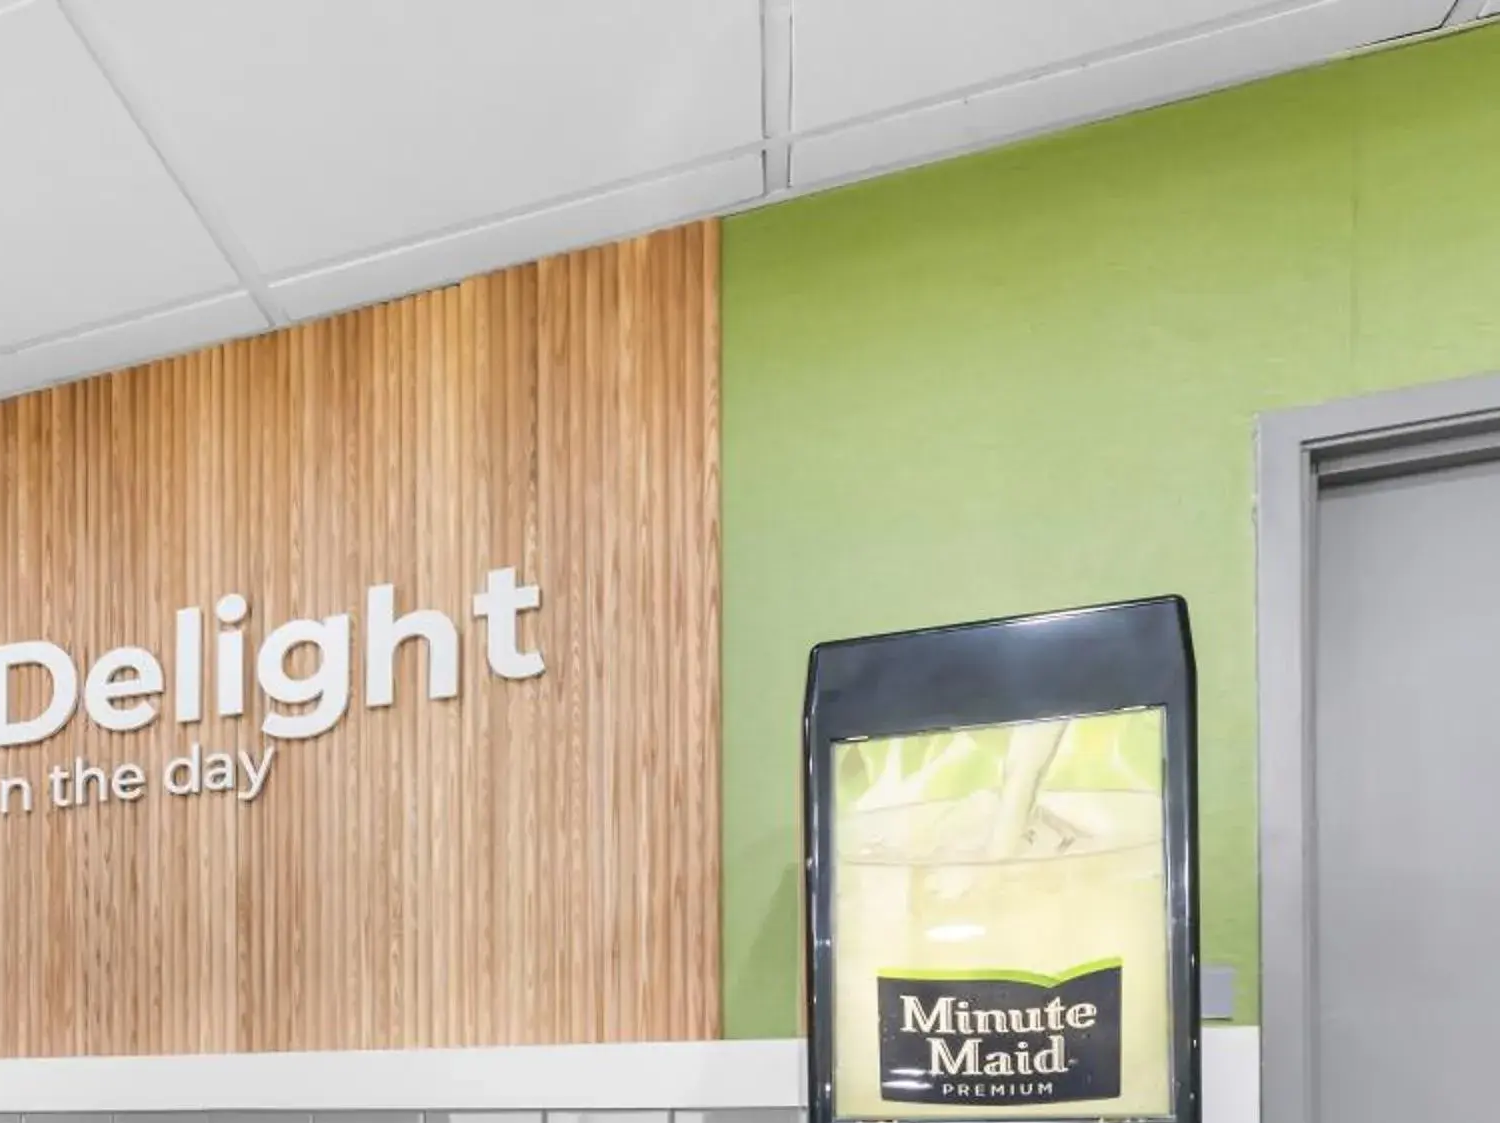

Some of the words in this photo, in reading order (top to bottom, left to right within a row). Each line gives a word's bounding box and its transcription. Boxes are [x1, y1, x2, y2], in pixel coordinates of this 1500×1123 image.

[48, 757, 145, 809] the
[163, 742, 277, 802] day
[900, 994, 1098, 1036] Minute
[925, 1034, 1070, 1077] Maid
[942, 1082, 1054, 1097] PREMIUM
